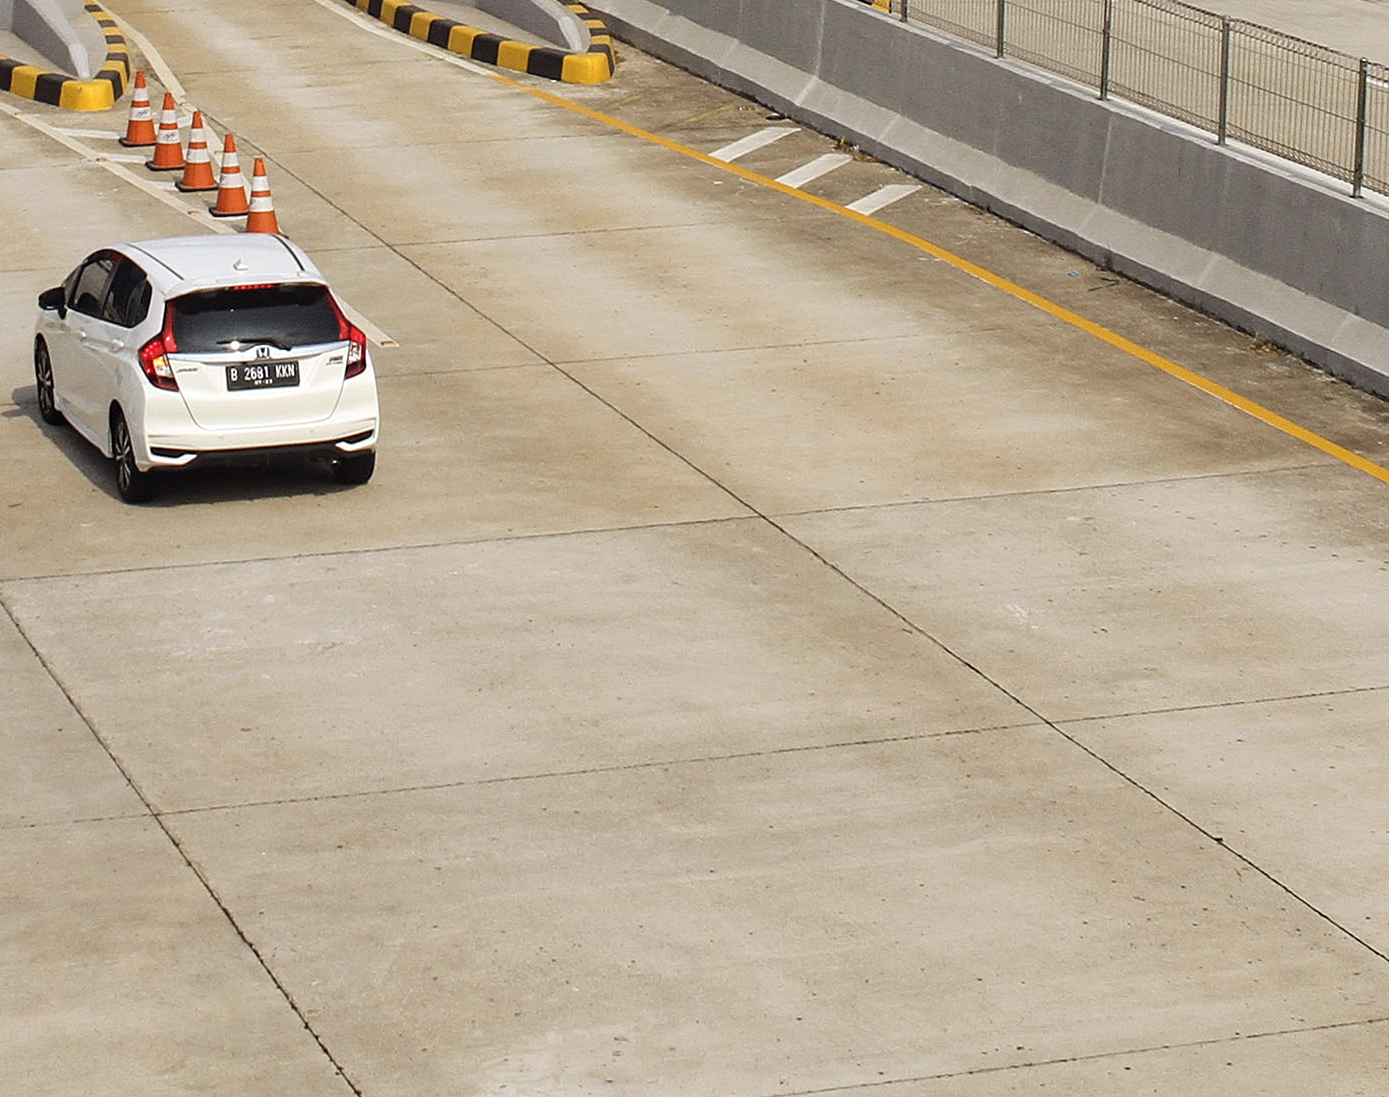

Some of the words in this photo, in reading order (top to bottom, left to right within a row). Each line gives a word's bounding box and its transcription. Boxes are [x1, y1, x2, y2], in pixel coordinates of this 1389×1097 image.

[230, 368, 238, 382] B
[244, 366, 269, 381] 2681
[275, 364, 295, 379] KKN
